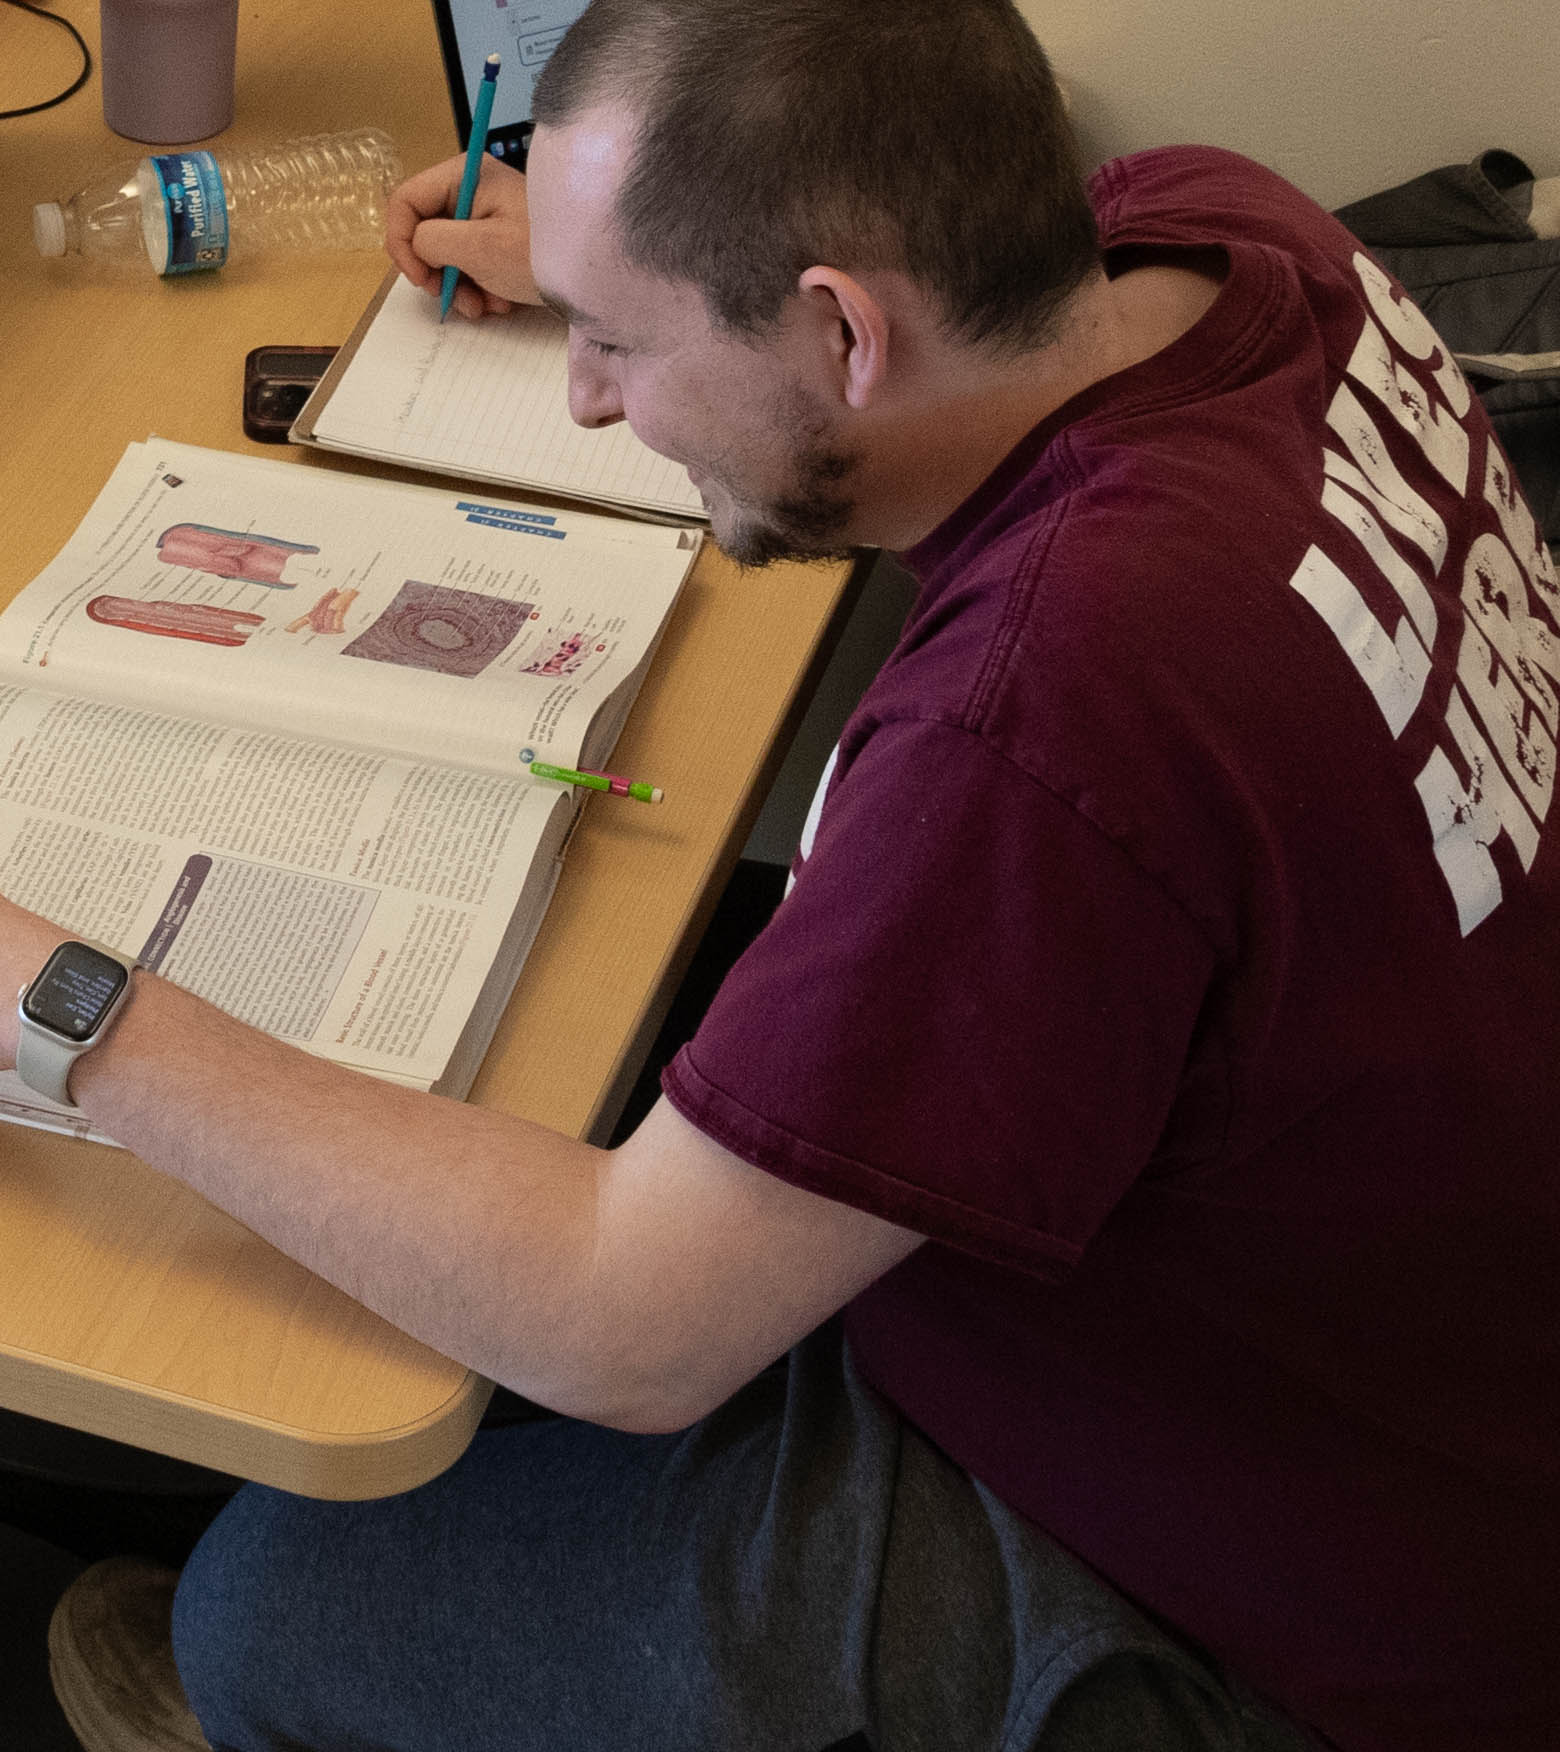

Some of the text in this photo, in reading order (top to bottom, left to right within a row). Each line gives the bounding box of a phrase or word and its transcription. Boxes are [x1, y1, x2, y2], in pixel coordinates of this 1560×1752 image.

[191, 189, 207, 238] Purified
[1289, 251, 1471, 740] LIVES
[343, 1000, 363, 1030] Structure
